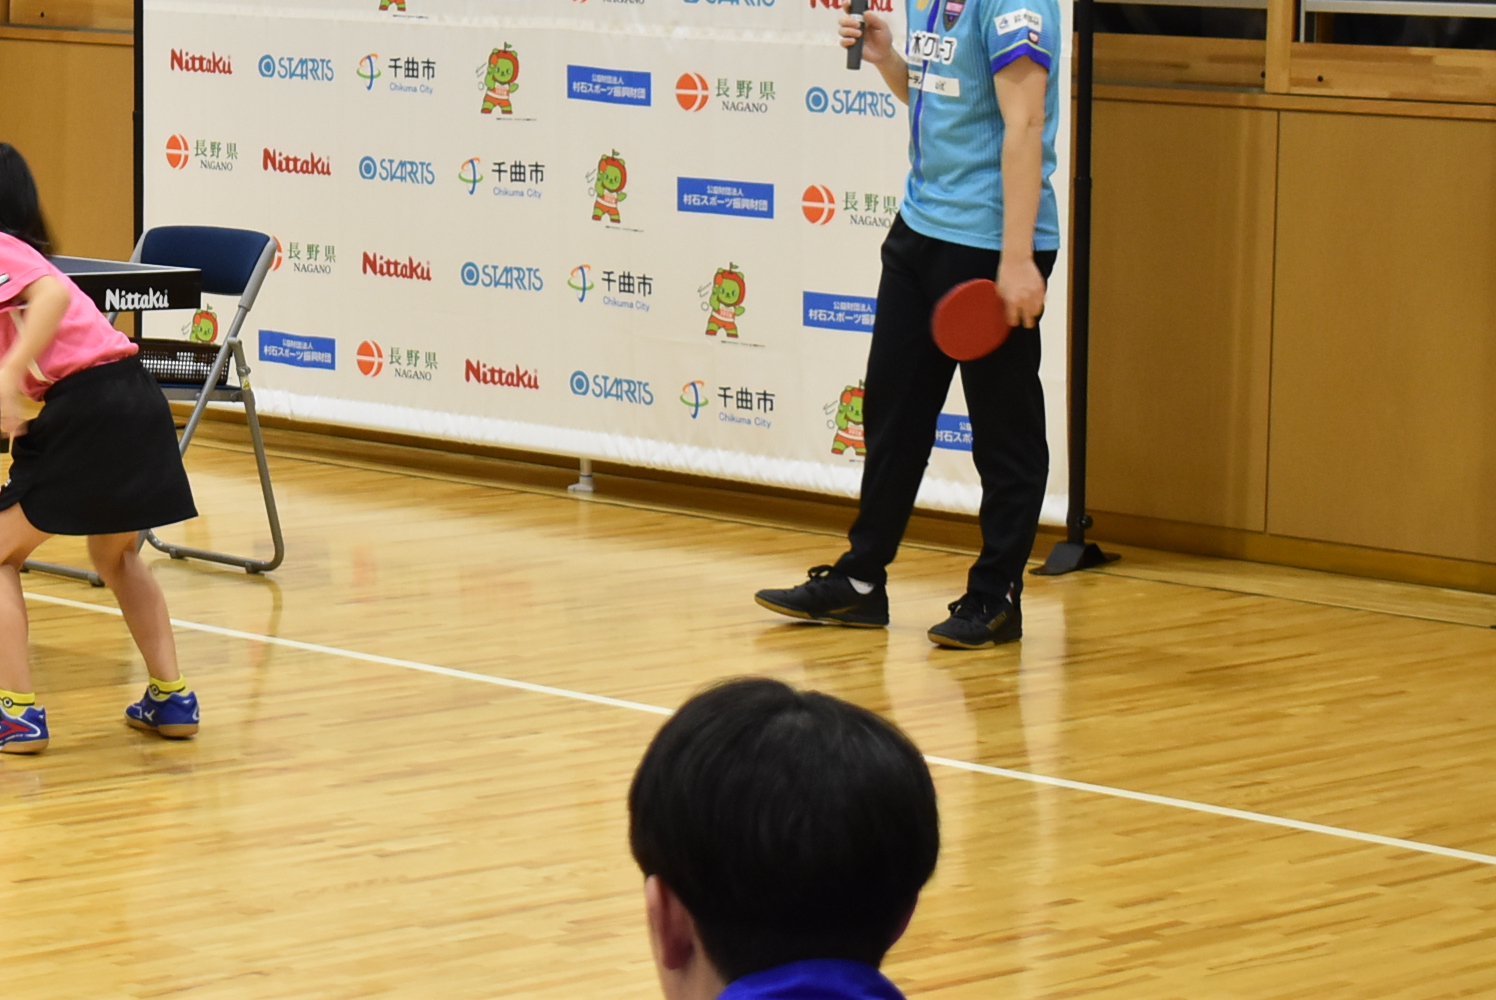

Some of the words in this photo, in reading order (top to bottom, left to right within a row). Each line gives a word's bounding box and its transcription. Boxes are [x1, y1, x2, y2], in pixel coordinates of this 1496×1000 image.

[170, 48, 232, 74] Nittaku
[388, 57, 436, 81] 千曲市
[389, 83, 417, 93] Chikuma
[418, 84, 434, 95] City
[715, 78, 776, 101] 長野県
[721, 100, 767, 113] NAGANO
[194, 139, 239, 160] 長野県
[200, 159, 233, 171] NAGANO
[262, 148, 331, 176] Nittaku
[491, 161, 545, 184] 千曲市
[493, 187, 524, 197] Chikuma
[527, 189, 542, 199] City
[842, 191, 898, 215] 長野県
[850, 214, 891, 228] NAGANO
[288, 242, 336, 264] 長野県
[293, 262, 332, 274] NAGANO
[362, 251, 431, 281] Nittaku
[601, 271, 653, 297] 千曲市
[105, 288, 169, 312] Nittaku
[602, 296, 634, 309] Chikuma
[635, 300, 650, 312] City
[389, 347, 439, 370] 長野県
[394, 367, 432, 381] NAGANO
[464, 358, 539, 390] Nittaku
[717, 387, 775, 413] 千曲市
[719, 412, 752, 425] Chikuma
[754, 416, 771, 428] City
